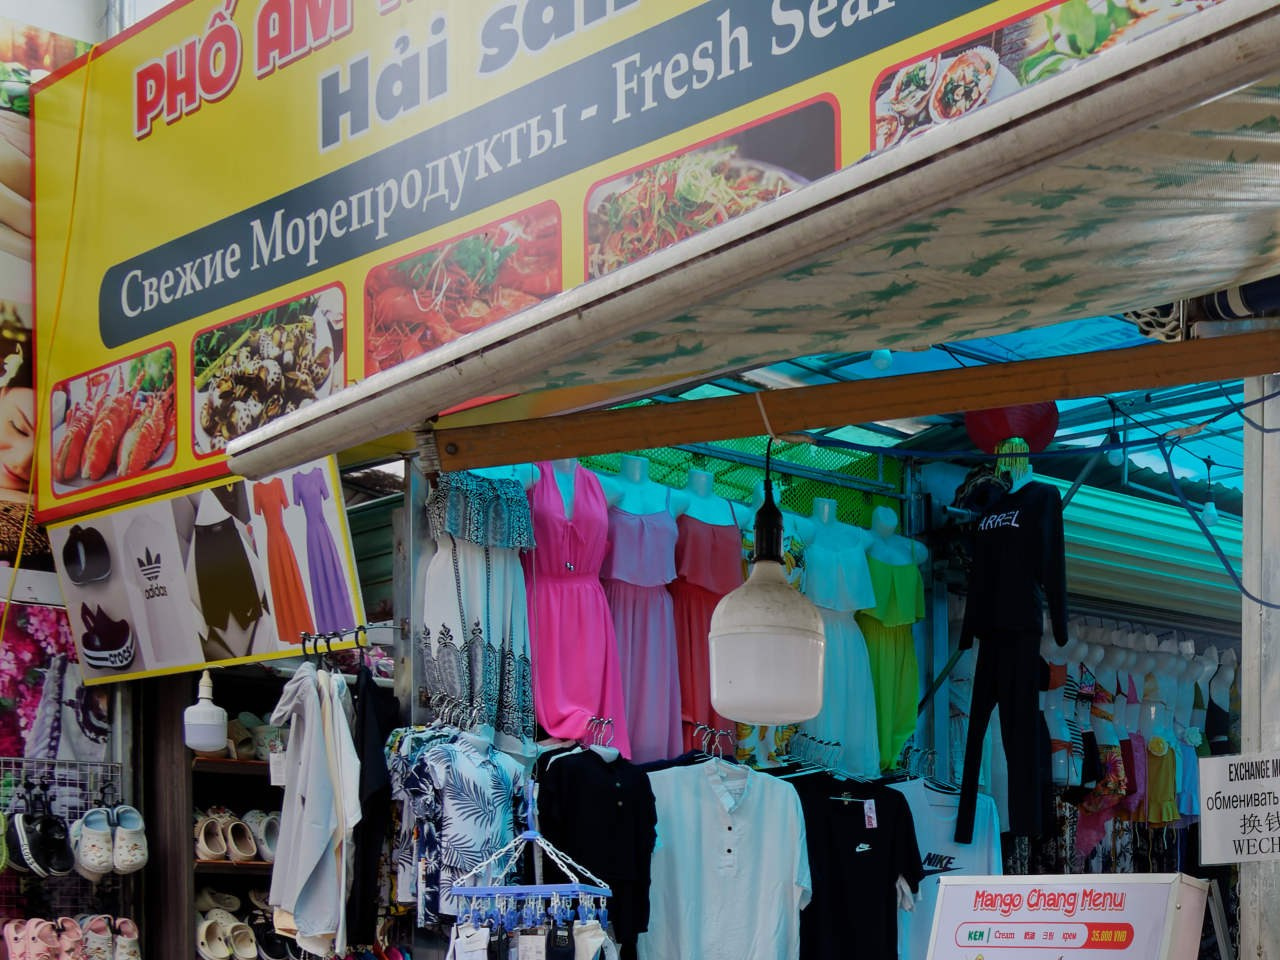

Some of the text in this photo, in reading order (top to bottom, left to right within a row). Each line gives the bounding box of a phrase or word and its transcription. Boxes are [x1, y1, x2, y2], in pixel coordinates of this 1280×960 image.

[611, 0, 897, 124] Fresh Sea
[320, 15, 449, 152] Hải
[121, 102, 568, 318] Свежие Морепродукты
[145, 584, 168, 600] adidas
[108, 647, 132, 665] crocs
[1228, 759, 1270, 781] EXCHANGE
[1206, 790, 1279, 811] обменивать
[922, 852, 956, 868] NIKE
[973, 888, 1127, 918] Mango Chang Menu
[967, 930, 984, 941] KEM
[994, 930, 1015, 940] Cream
